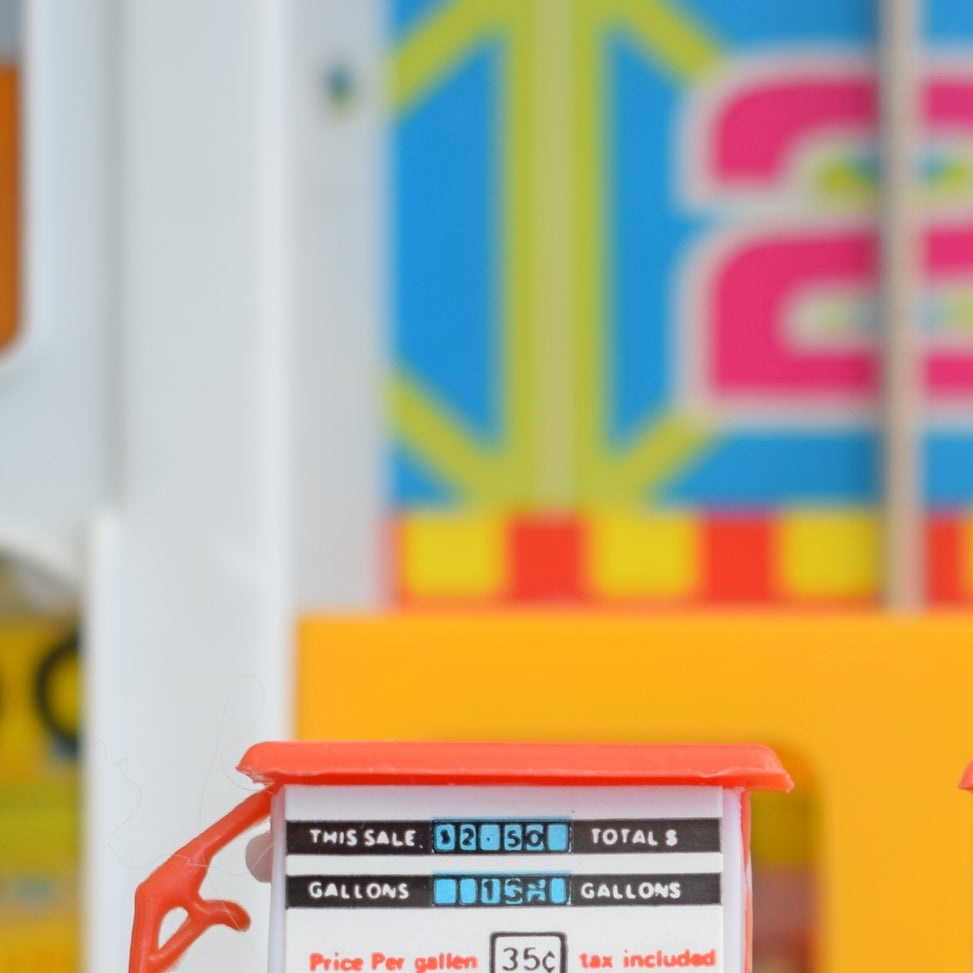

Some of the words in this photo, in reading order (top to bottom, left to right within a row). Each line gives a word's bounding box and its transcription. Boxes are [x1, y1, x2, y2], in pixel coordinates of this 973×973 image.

[309, 829, 361, 846] THIS
[364, 828, 417, 847] SALE
[591, 827, 659, 847] TOTAL
[308, 882, 410, 899] GALLONS
[581, 881, 682, 899] GALLONS
[309, 952, 363, 971] Price
[371, 952, 405, 971] Per
[501, 946, 557, 973] 35¢
[580, 952, 613, 969] tax
[623, 948, 717, 968] included
